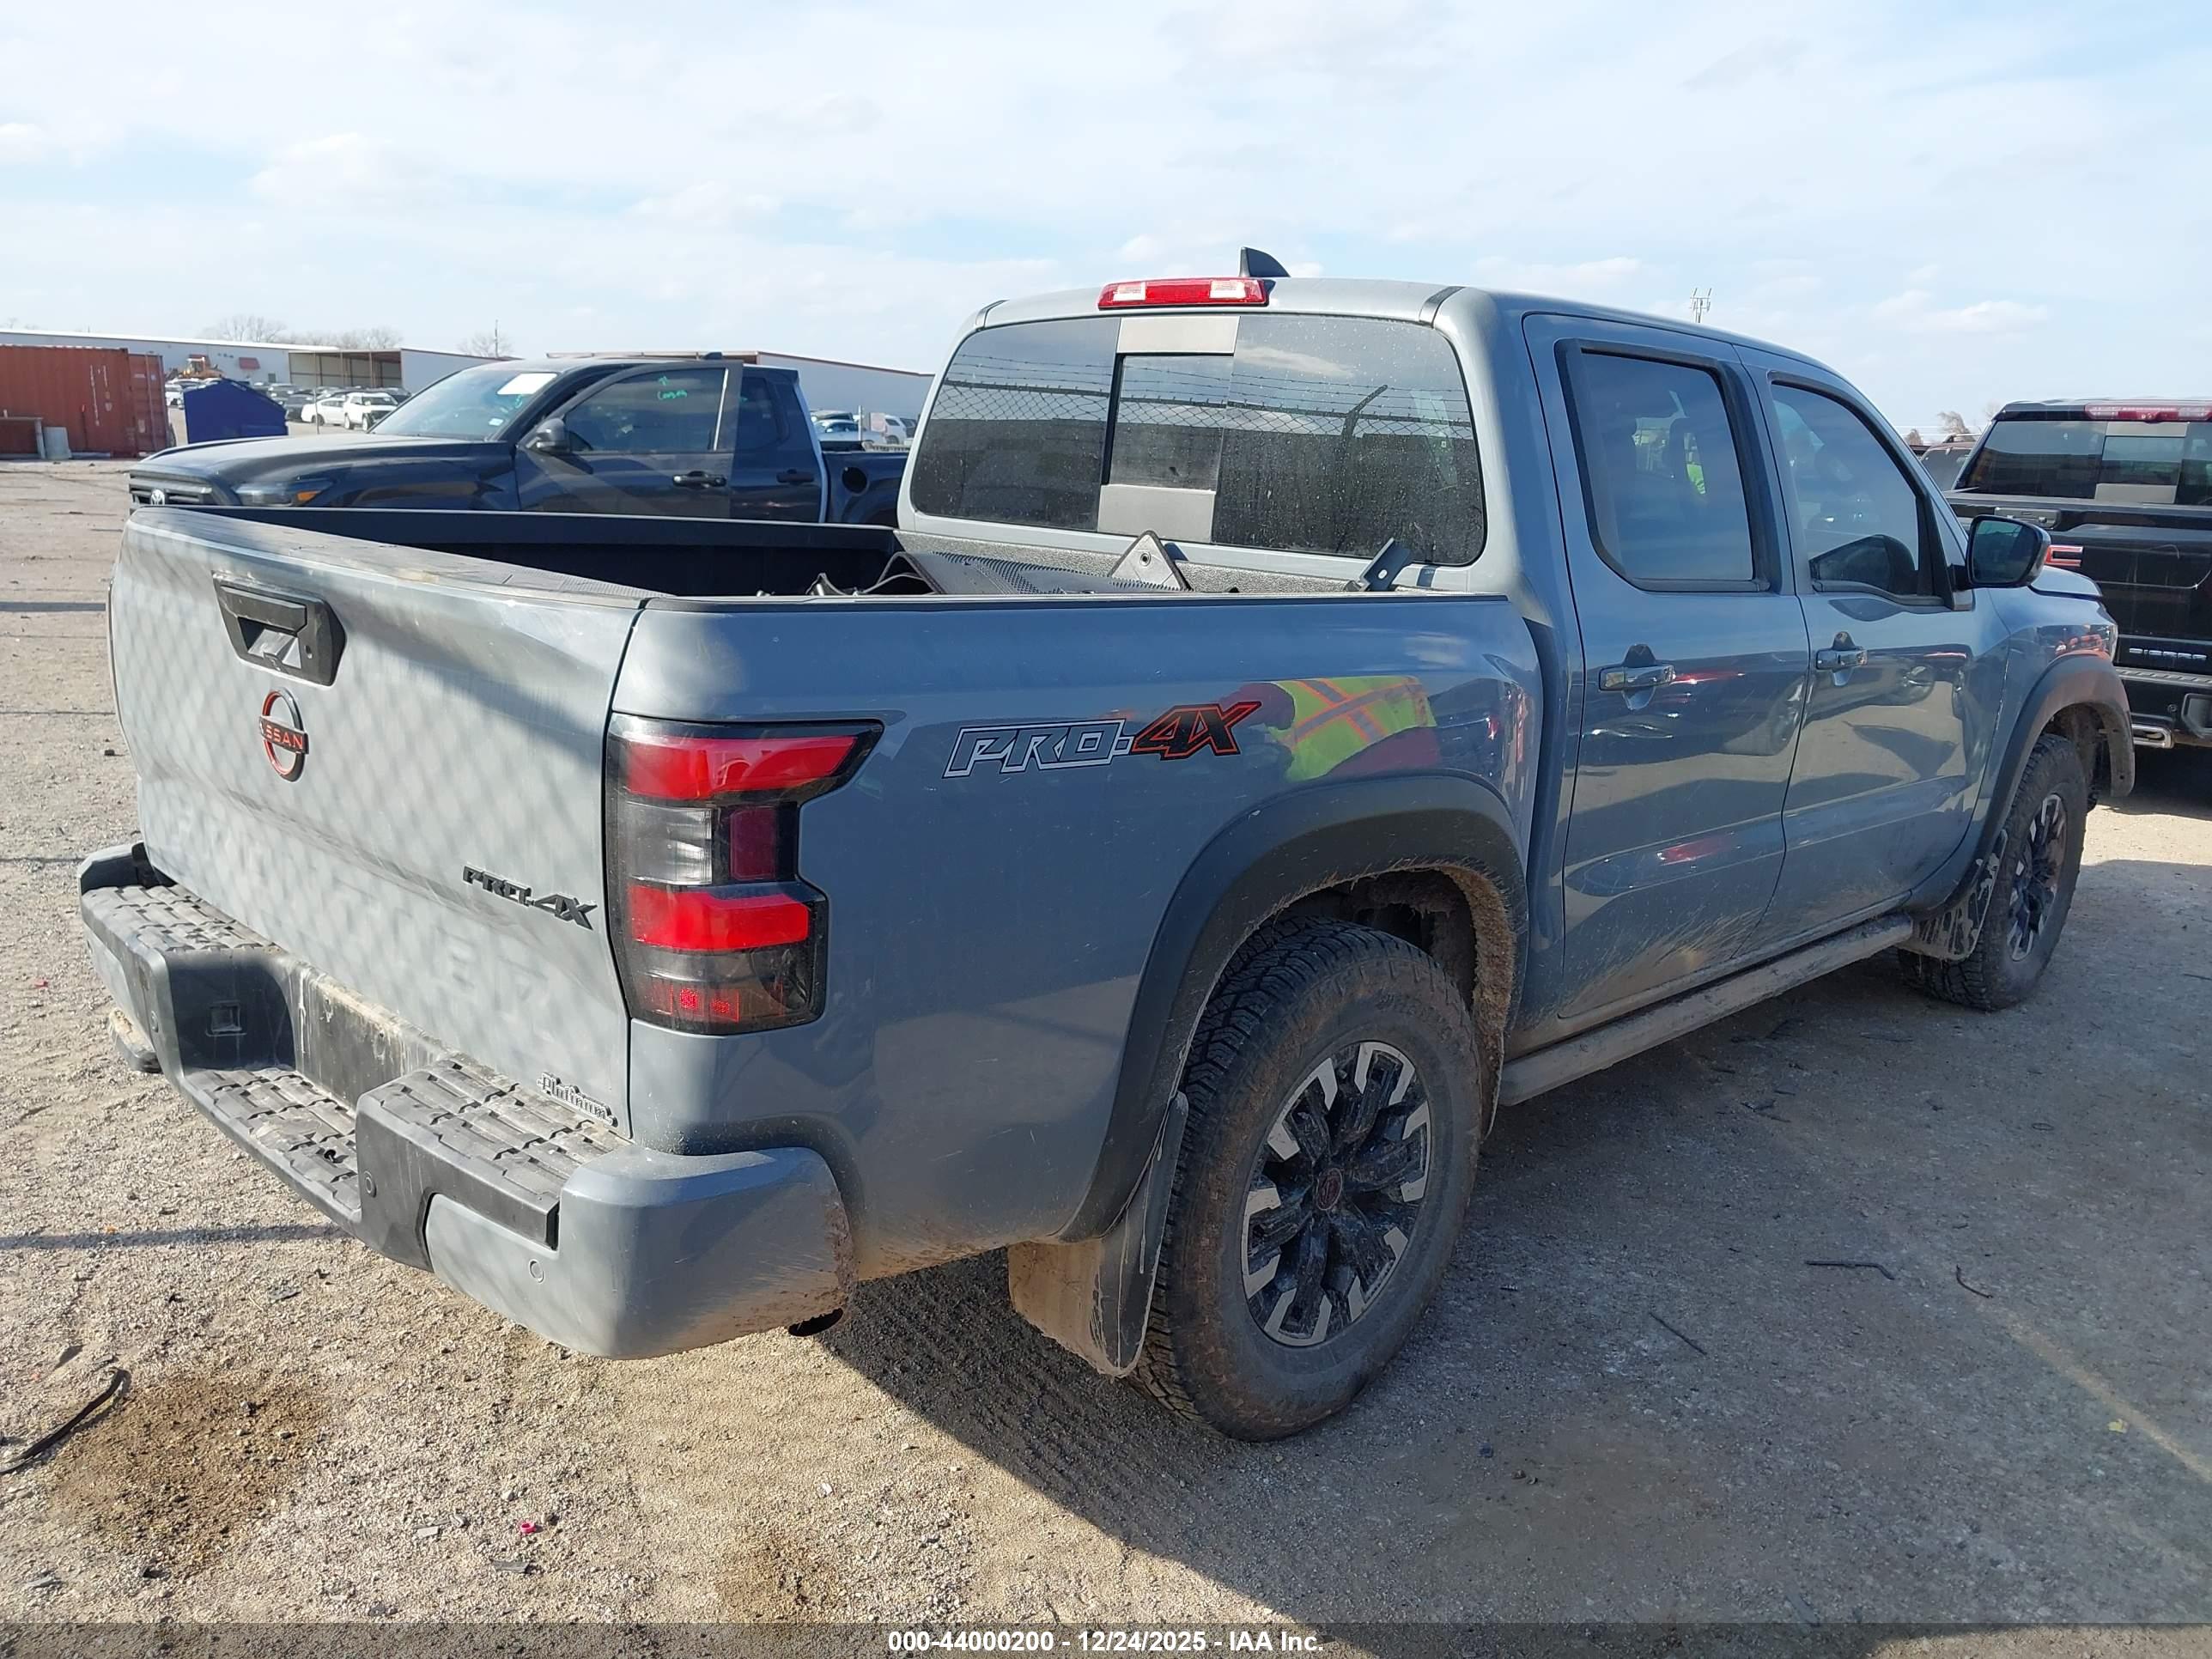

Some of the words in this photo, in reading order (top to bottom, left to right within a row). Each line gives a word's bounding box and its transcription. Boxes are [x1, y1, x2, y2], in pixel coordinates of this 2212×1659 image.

[259, 721, 303, 750] SSAN
[942, 701, 1262, 779] PRO-4X
[463, 865, 599, 931] PRO-4X
